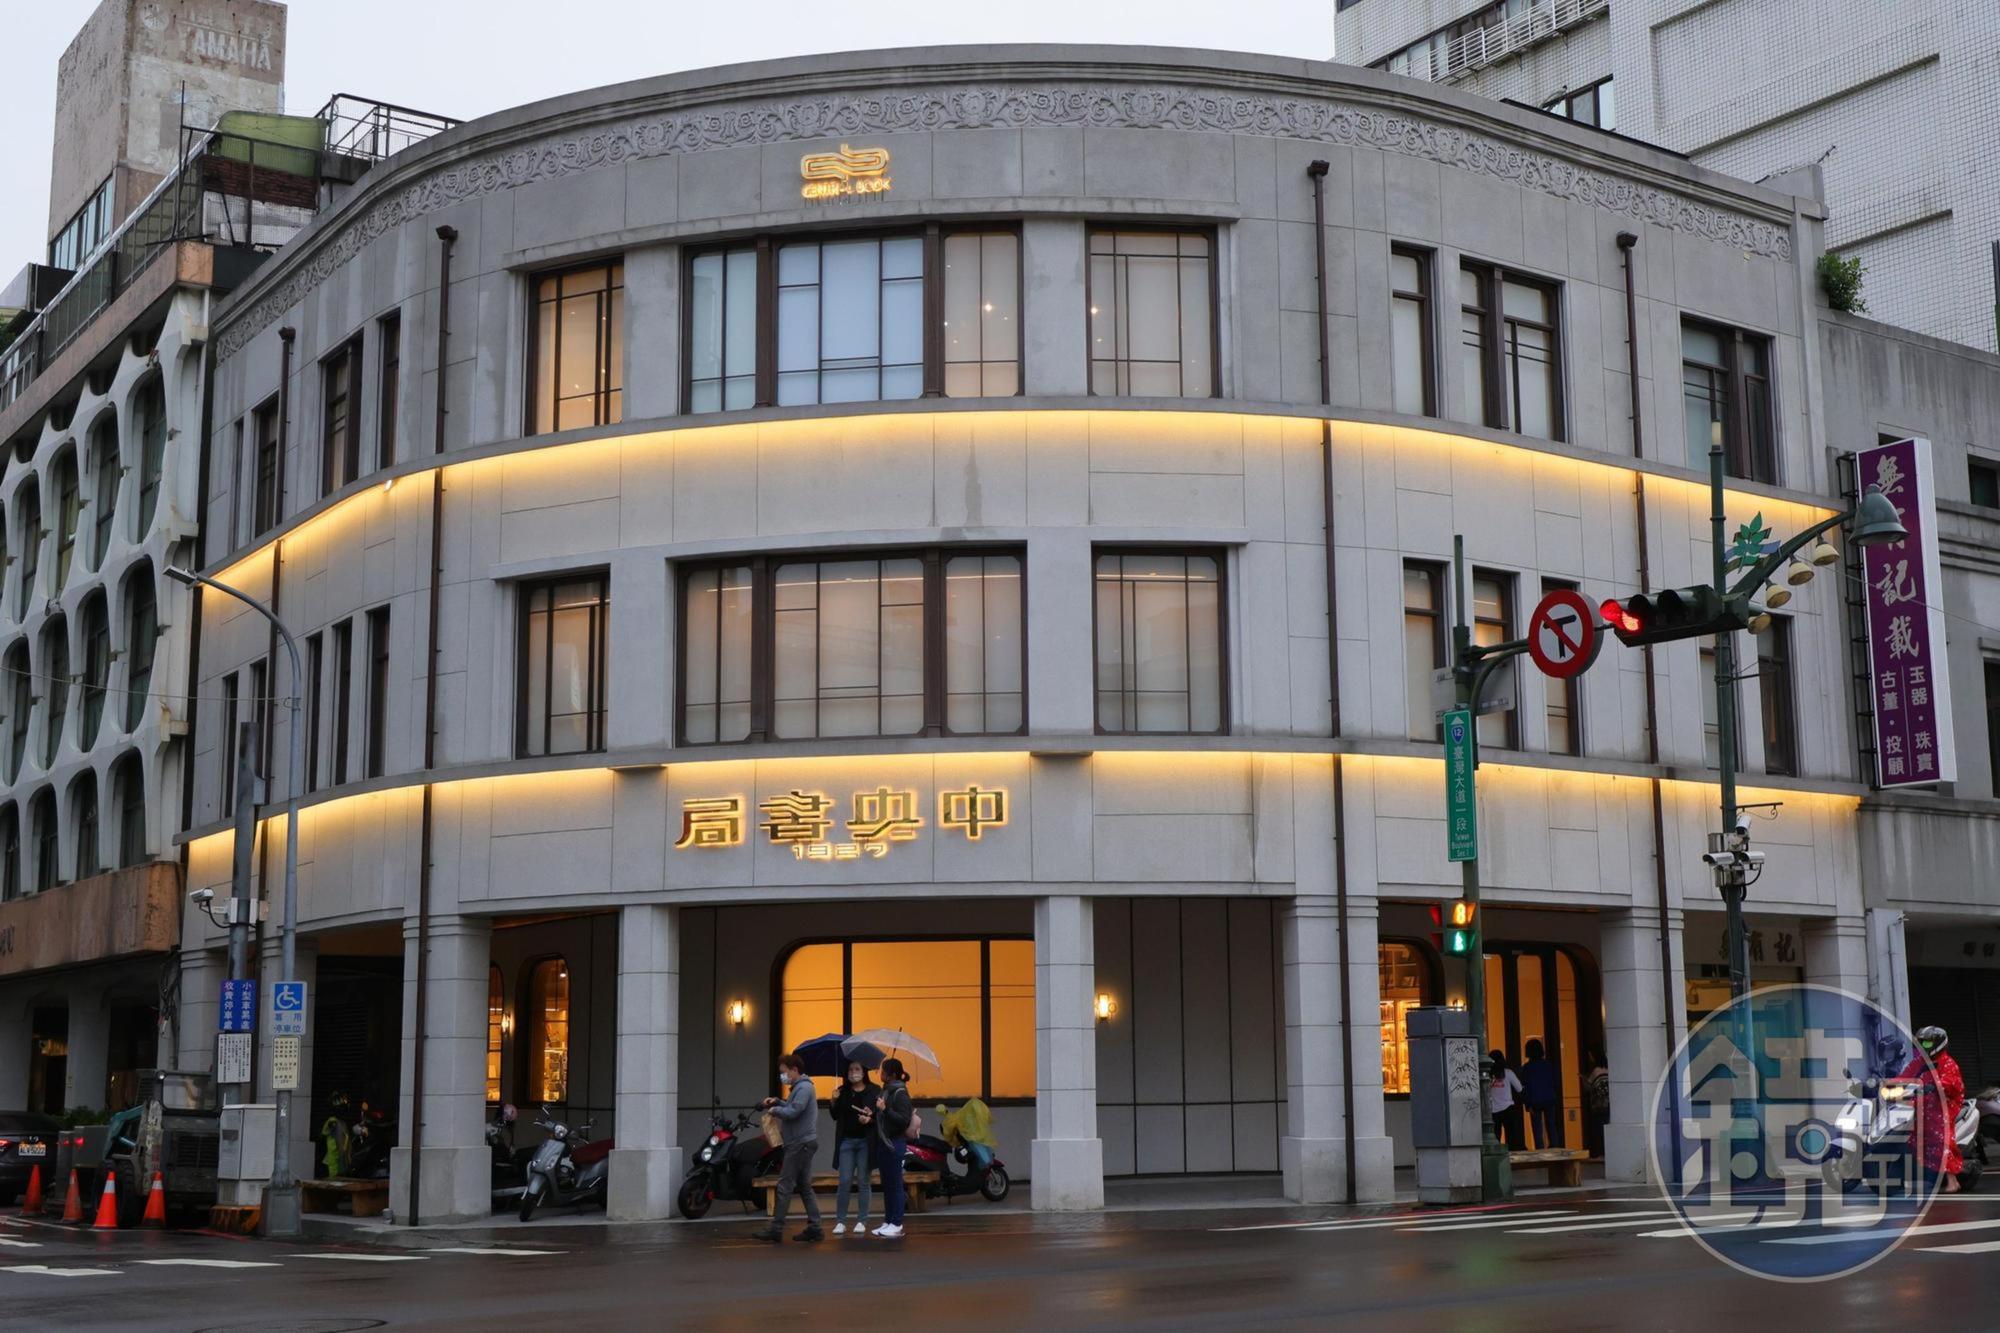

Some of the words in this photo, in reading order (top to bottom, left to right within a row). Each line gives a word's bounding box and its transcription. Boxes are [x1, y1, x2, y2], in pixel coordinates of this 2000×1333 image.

[1453, 745, 1467, 831] 臺灣大道一段
[792, 842, 888, 859] 1927
